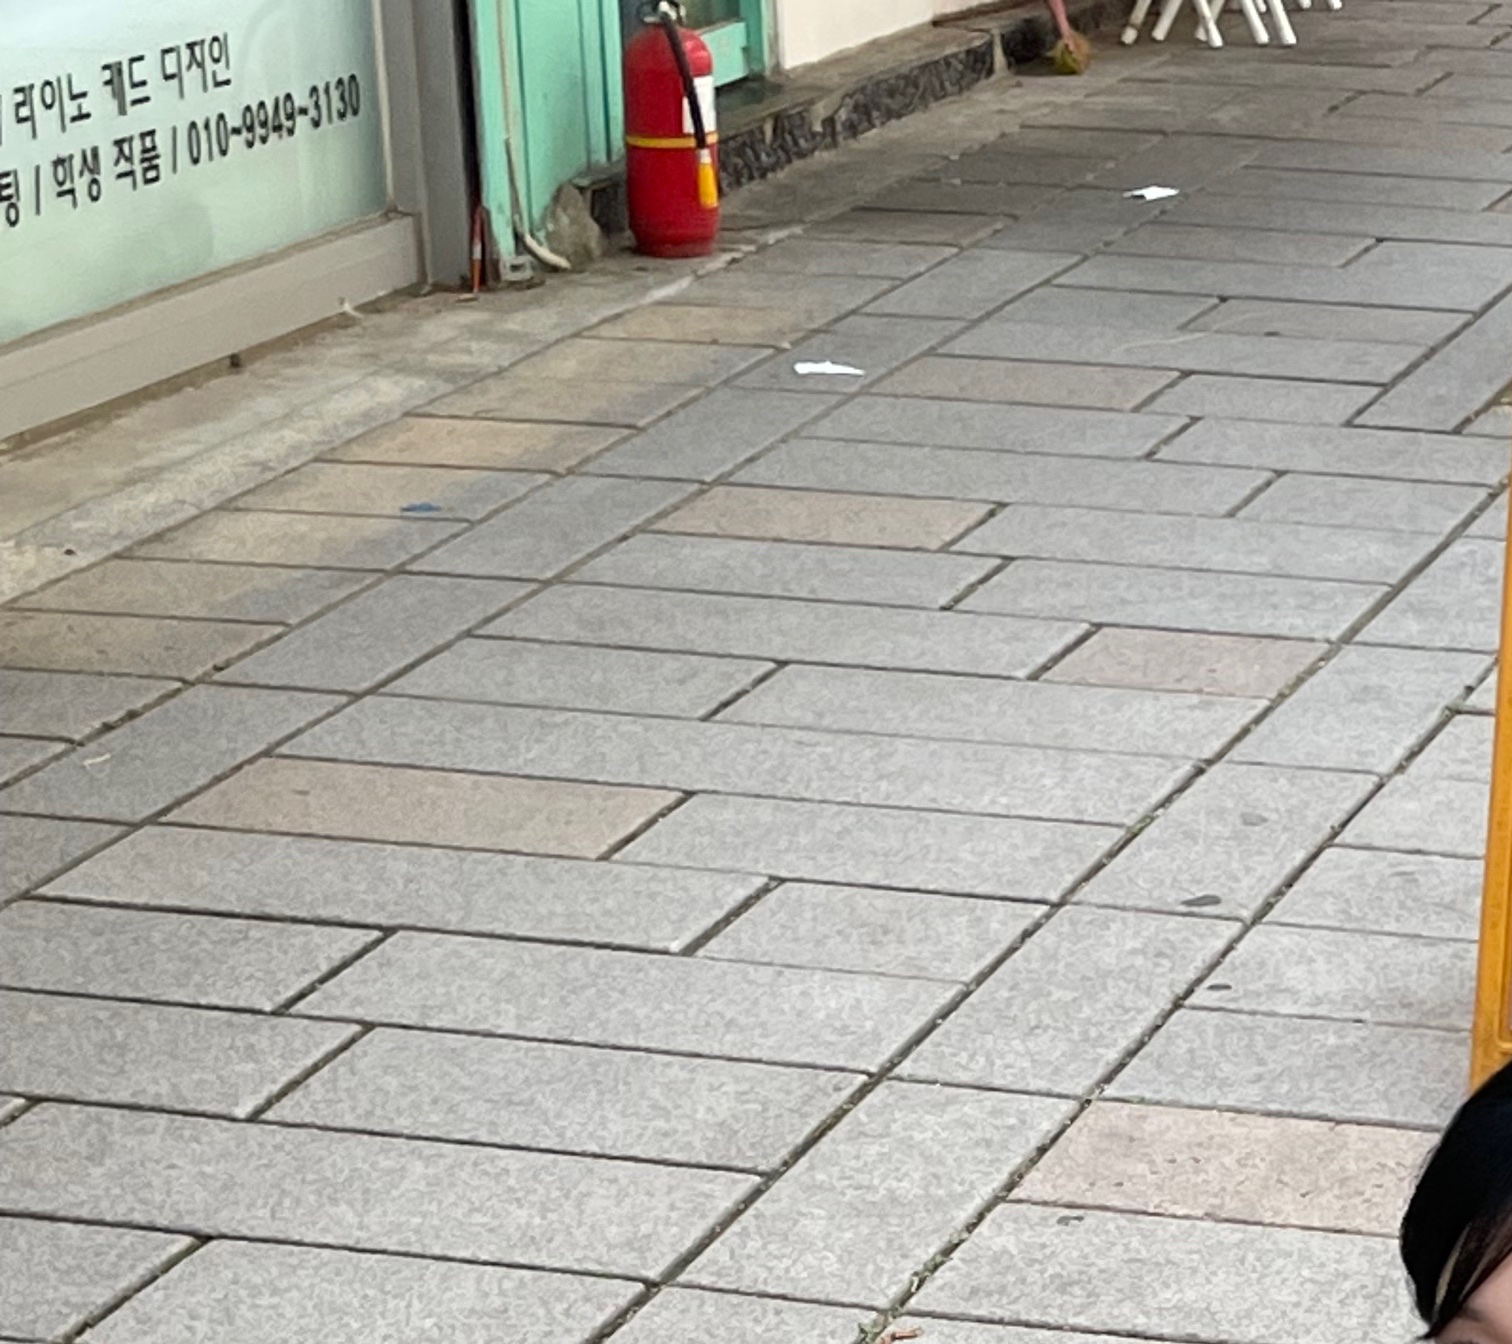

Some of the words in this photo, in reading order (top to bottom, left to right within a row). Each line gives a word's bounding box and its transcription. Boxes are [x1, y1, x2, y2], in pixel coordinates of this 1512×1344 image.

[13, 73, 92, 140] 라이노
[160, 33, 232, 99] 디자인
[52, 145, 101, 210] 학생
[113, 128, 161, 192] 작품
